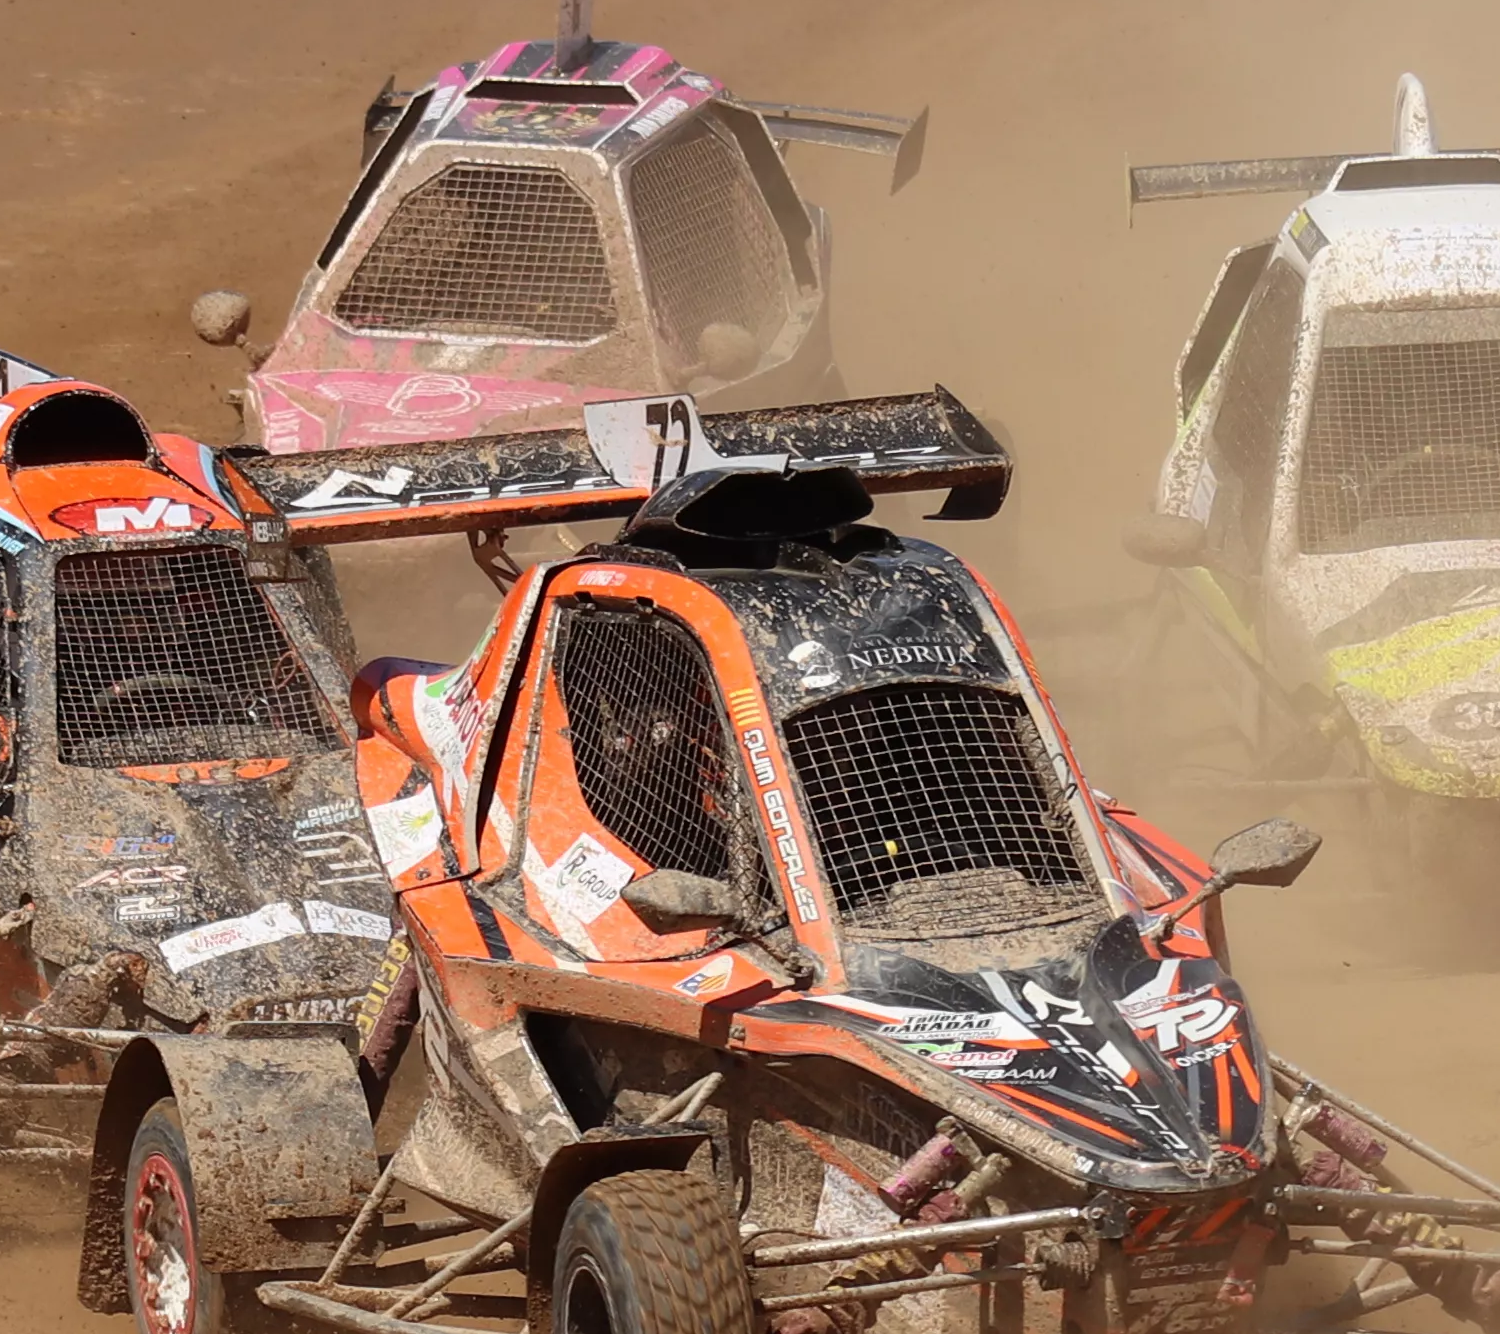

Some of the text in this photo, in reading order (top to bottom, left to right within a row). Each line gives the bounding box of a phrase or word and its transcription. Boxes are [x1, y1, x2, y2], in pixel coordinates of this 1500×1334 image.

[848, 645, 977, 669] NEBRIJA
[744, 728, 777, 786] QUIM
[578, 869, 618, 902] GROUP
